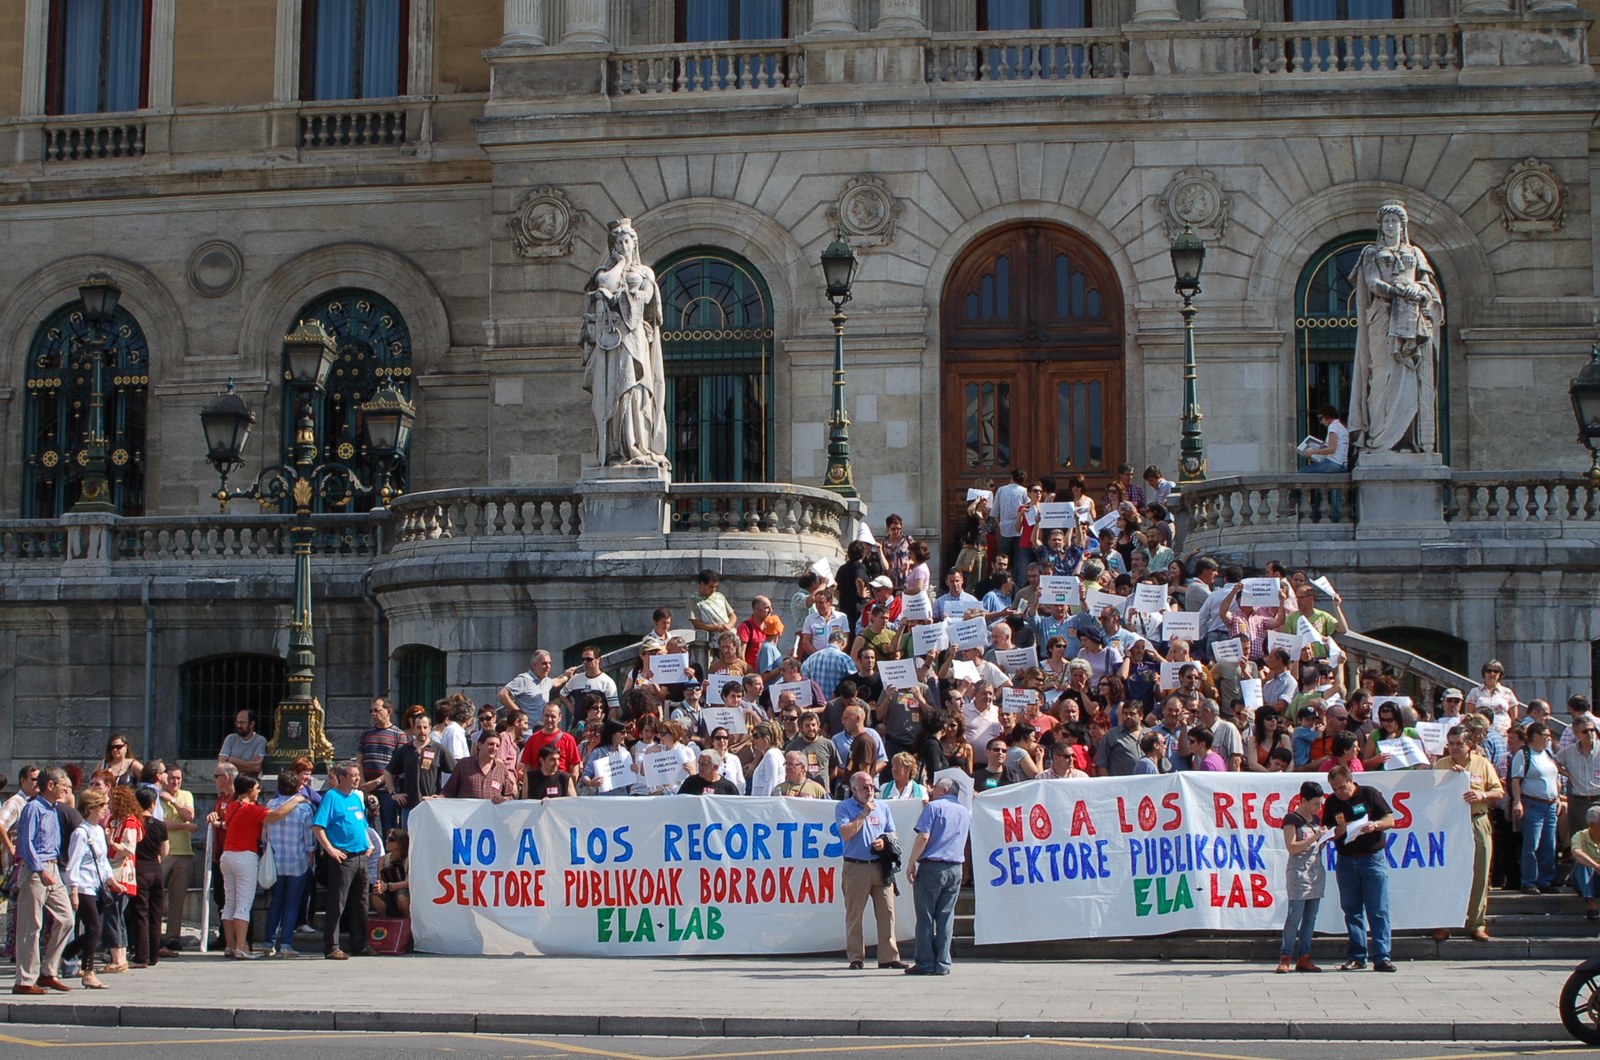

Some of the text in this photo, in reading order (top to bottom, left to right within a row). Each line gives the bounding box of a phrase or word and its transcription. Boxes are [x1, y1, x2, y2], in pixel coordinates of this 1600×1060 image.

[1002, 804, 1052, 843] NO
[1070, 800, 1096, 837] A
[1117, 792, 1182, 833] LOS
[452, 821, 844, 866] NO A LOS RECORTES
[989, 838, 1112, 888] SEKTORE
[1129, 833, 1267, 878] PUBLIKOAK
[433, 866, 835, 908] SEKTORE PUBLIKOAK BORROKAN
